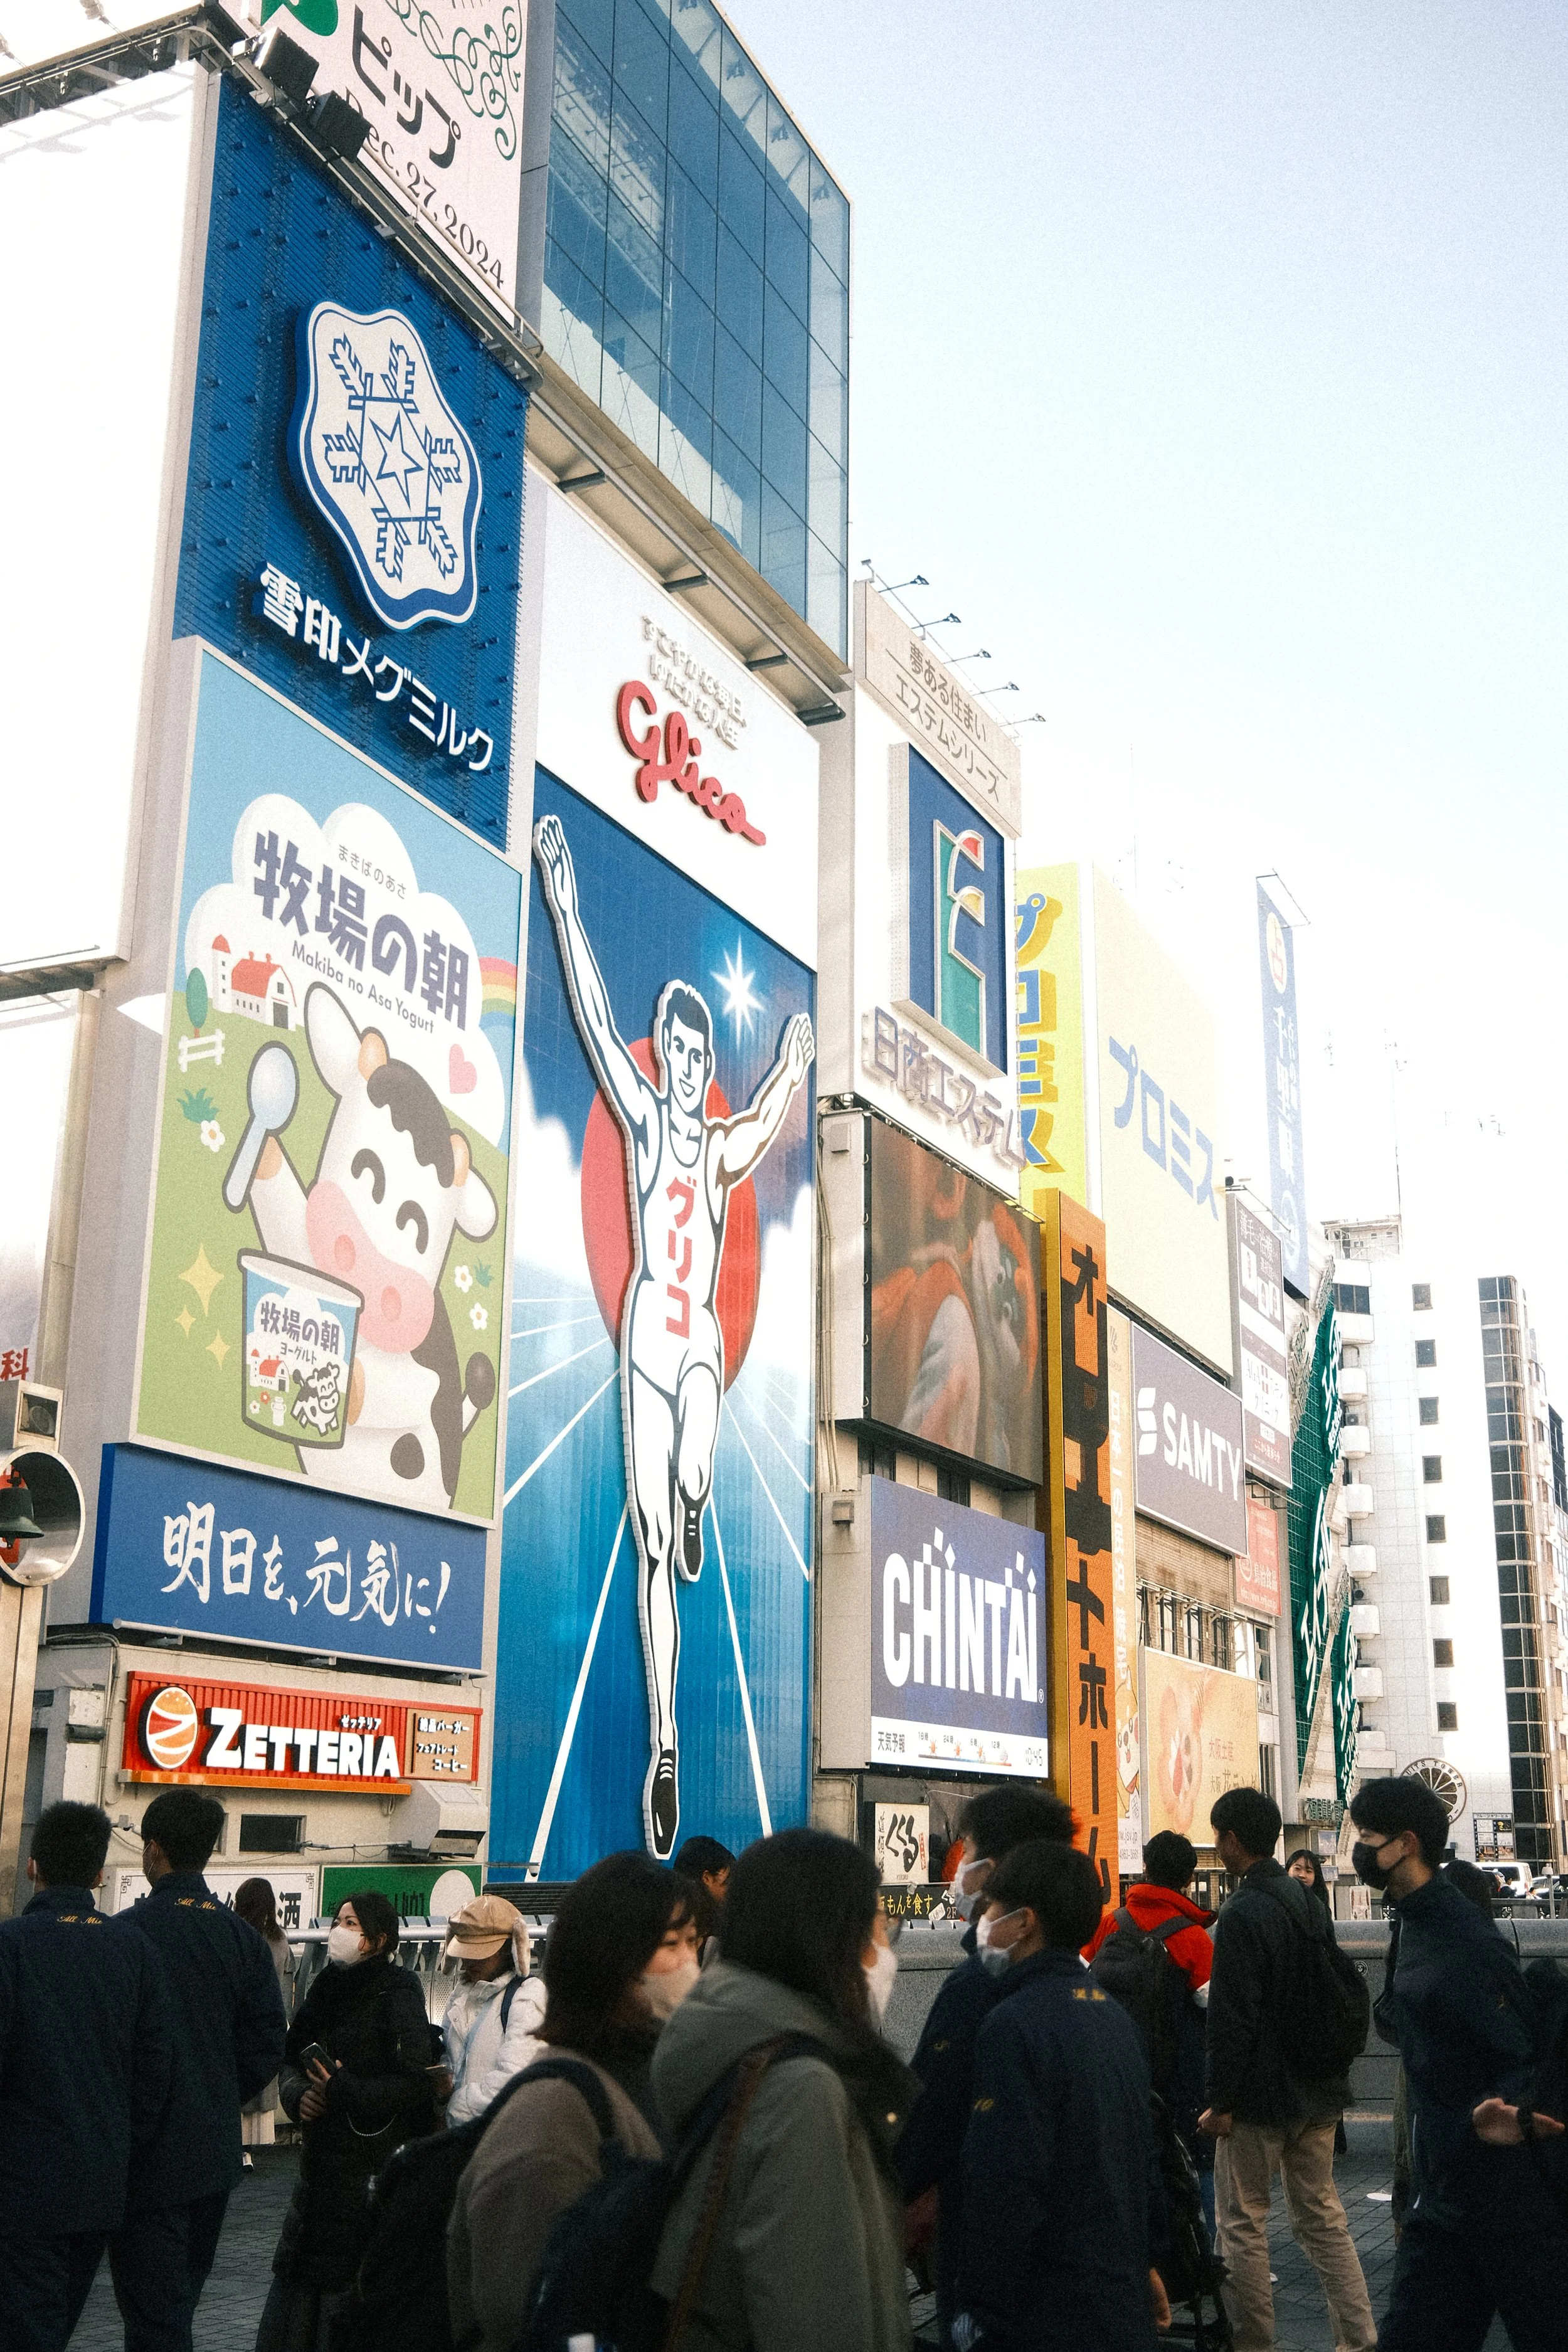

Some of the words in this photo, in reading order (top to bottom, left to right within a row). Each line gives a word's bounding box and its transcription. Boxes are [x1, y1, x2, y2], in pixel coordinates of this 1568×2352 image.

[352, 3, 461, 169] ピップ
[407, 162, 438, 221] 27,
[445, 204, 504, 289] 2024
[260, 562, 494, 771] 雪印メグミルク
[909, 640, 987, 743] 夢ある住まい
[617, 679, 766, 847] Glico
[896, 673, 1000, 803] エステムシリーズ
[338, 844, 407, 900] まきばのあさ
[253, 829, 469, 1031] 牧場の朝
[292, 940, 344, 983] Makiba
[348, 978, 364, 995] no
[368, 985, 392, 1011] Asa
[395, 997, 435, 1034] Yogurt
[861, 1005, 1027, 1168] 日商エステム
[1108, 1035, 1219, 1222] プロミス
[666, 1175, 697, 1340] グリコ
[261, 1301, 340, 1355] 牧場の朝
[280, 1342, 317, 1365] ヨーグルト
[1163, 1401, 1241, 1501] SAMTY
[883, 1528, 1037, 1703] CHINTAI
[205, 1707, 400, 1777] ZETTERIA
[341, 1714, 381, 1730] ゼッテリア
[417, 1743, 458, 1756] フェアトレード
[418, 1717, 470, 1734] 絶品バーガー
[434, 1759, 468, 1772] コーヒー
[877, 1731, 905, 1753] 天気予報
[1434, 1761, 1463, 1788] TOWER
[885, 1813, 919, 1873] くくる
[946, 1906, 958, 1919] 2F
